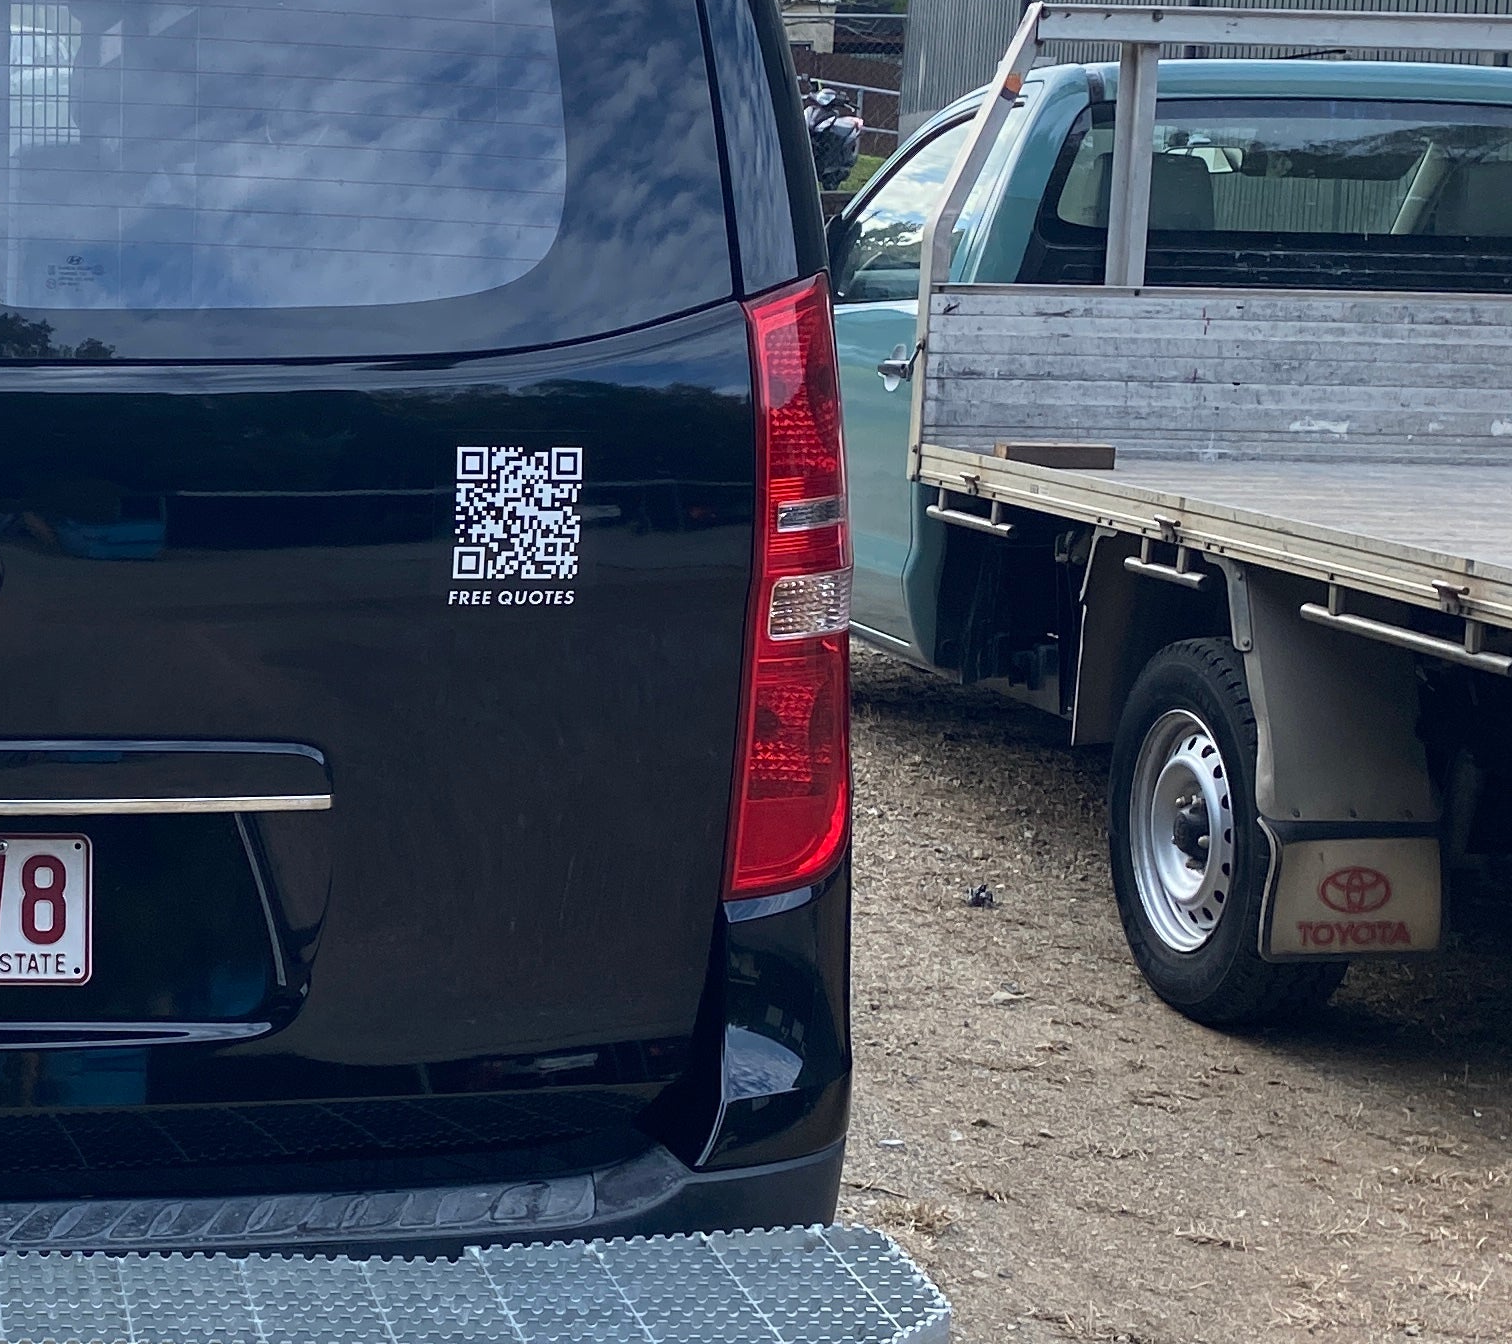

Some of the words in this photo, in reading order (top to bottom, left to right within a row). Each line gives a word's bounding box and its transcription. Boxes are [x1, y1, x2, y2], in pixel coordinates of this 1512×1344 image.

[448, 590, 492, 605] FREE
[497, 590, 575, 605] QUOTES
[1297, 921, 1412, 947] TOYOTA
